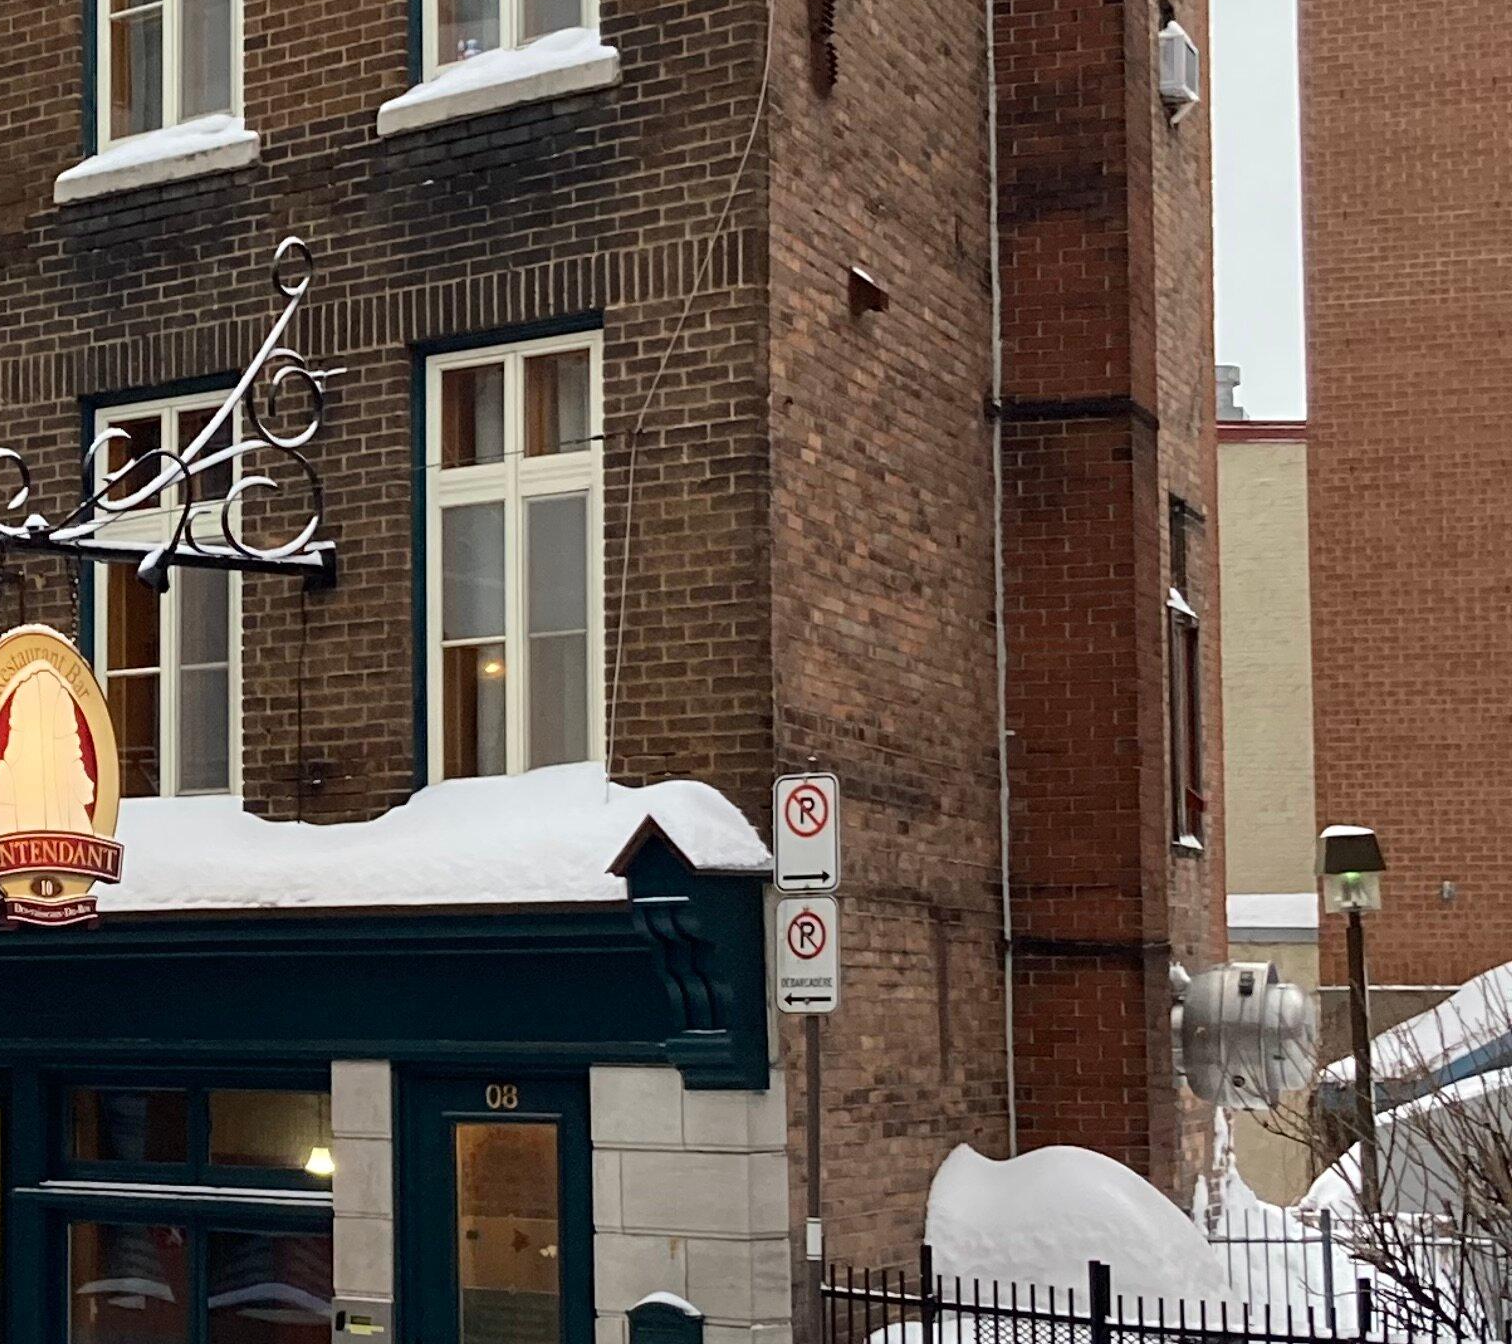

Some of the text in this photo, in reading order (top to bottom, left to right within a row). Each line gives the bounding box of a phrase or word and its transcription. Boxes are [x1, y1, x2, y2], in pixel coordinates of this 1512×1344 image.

[65, 663, 89, 699] Bar
[41, 880, 54, 896] 10
[486, 1084, 518, 1109] 08
